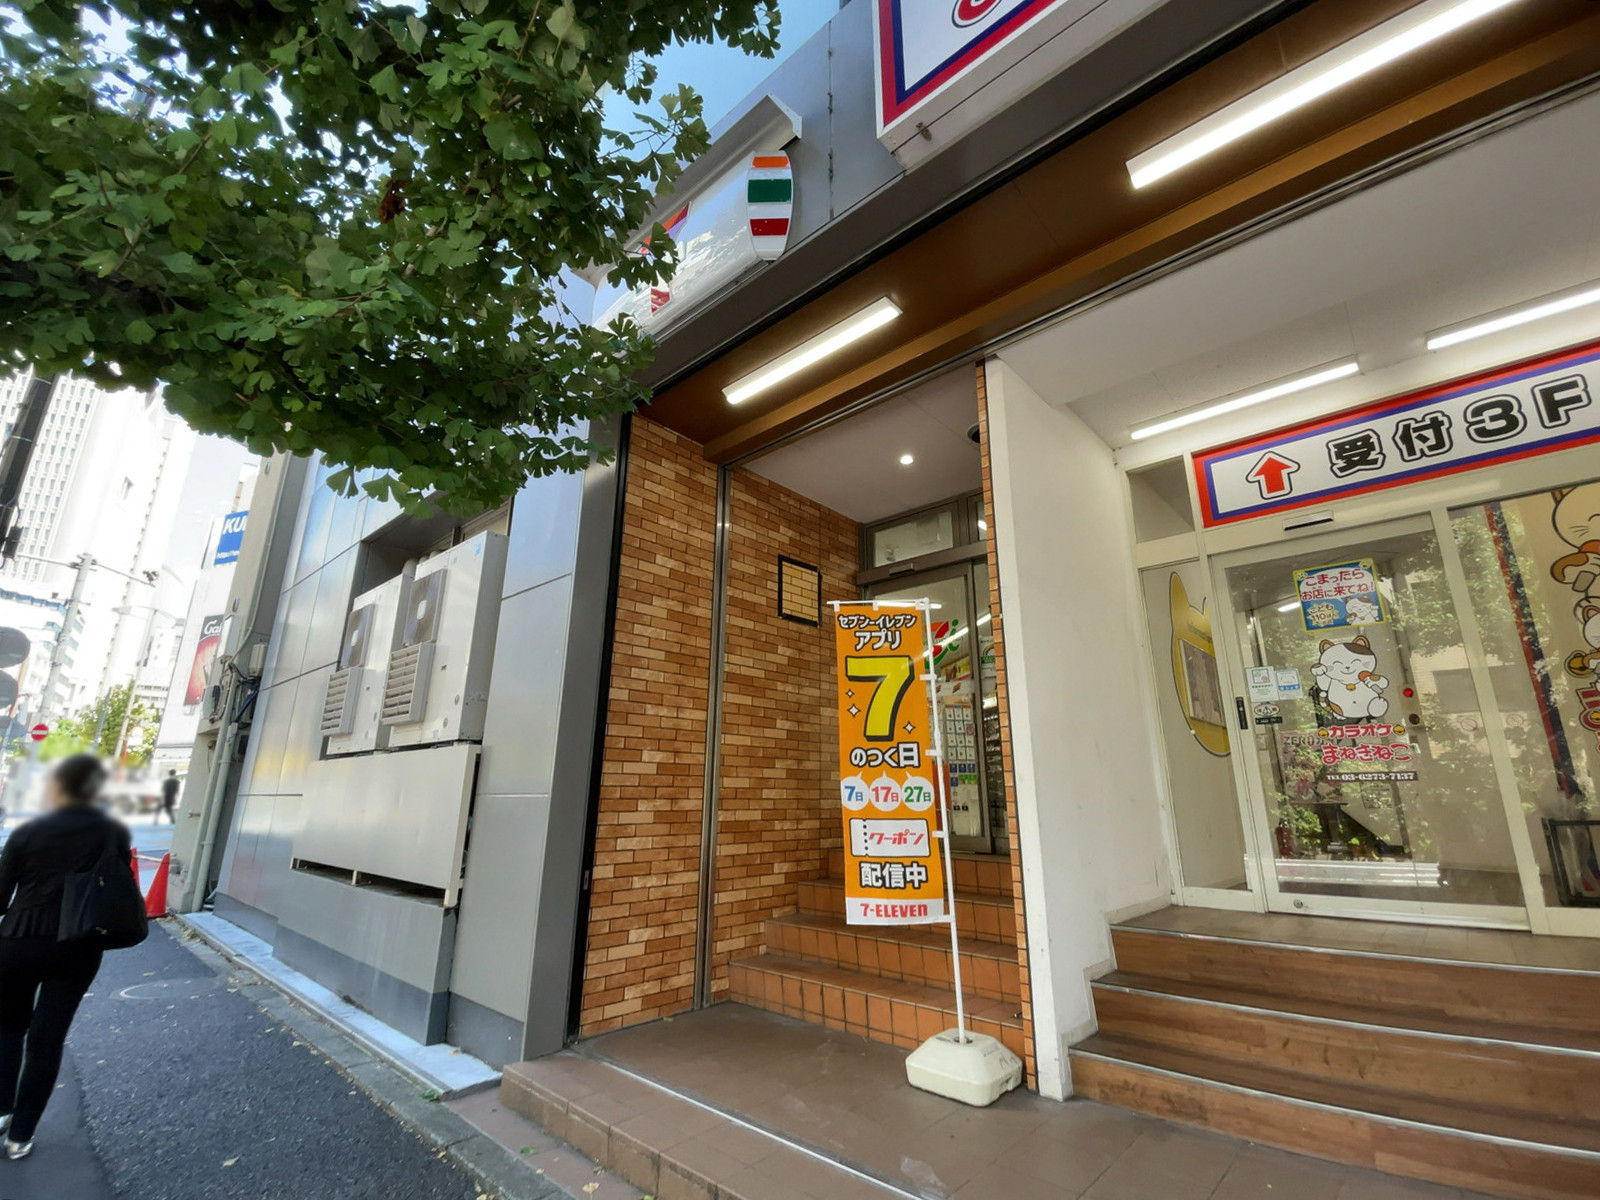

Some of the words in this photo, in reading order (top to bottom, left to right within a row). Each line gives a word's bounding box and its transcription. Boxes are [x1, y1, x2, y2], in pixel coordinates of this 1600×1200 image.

[1326, 373, 1592, 478] 受付3F
[222, 515, 248, 535] KU
[1305, 568, 1365, 586] こまったら
[854, 628, 902, 651] アプリ
[845, 655, 914, 741] 7
[1328, 724, 1392, 738] カラオケ
[850, 741, 920, 768] のつく日
[1322, 744, 1412, 765] まねきねこ
[845, 785, 864, 802] 7日
[872, 785, 899, 803] 17日
[904, 785, 931, 803] 27日
[869, 828, 925, 846] クーポン
[859, 861, 928, 889] 配信中
